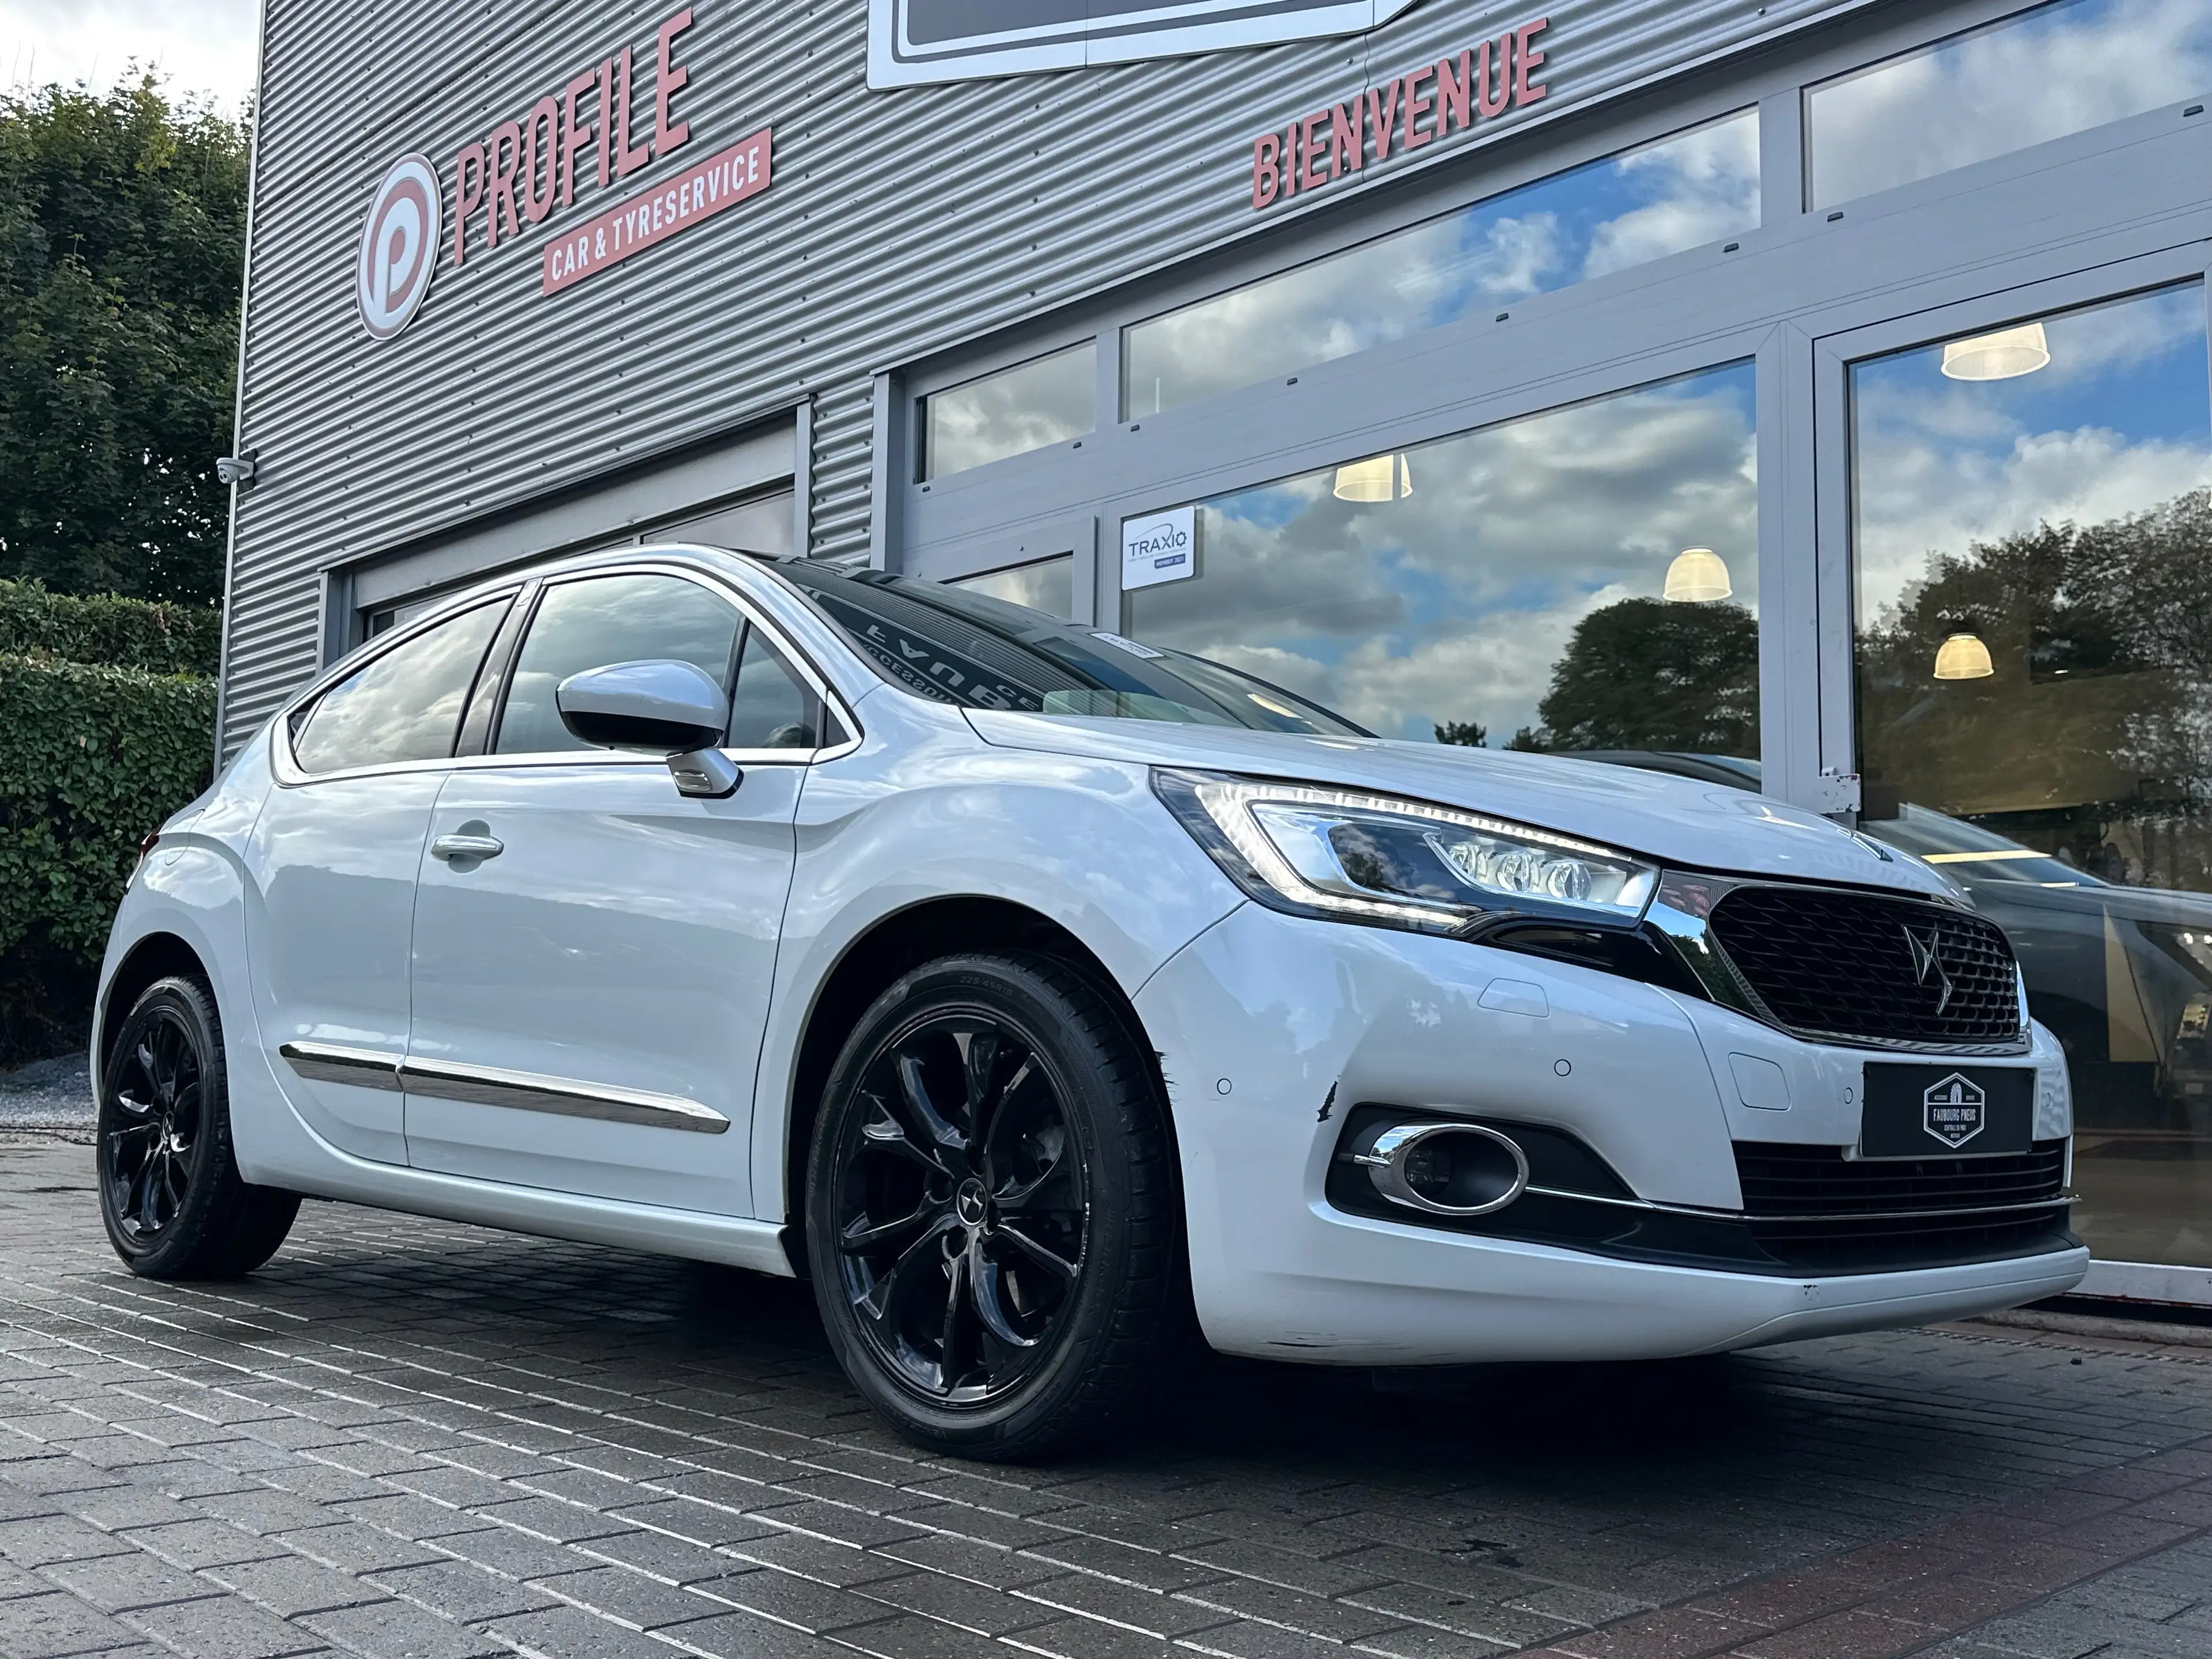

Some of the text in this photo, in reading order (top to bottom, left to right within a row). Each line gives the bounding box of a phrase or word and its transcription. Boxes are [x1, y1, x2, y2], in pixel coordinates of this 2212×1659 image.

[454, 6, 692, 267] PROFILE
[1252, 17, 1548, 211] BIENVENUE
[551, 146, 760, 281] CAR & TYRESERVICE
[1128, 531, 1187, 556] TRAXIO
